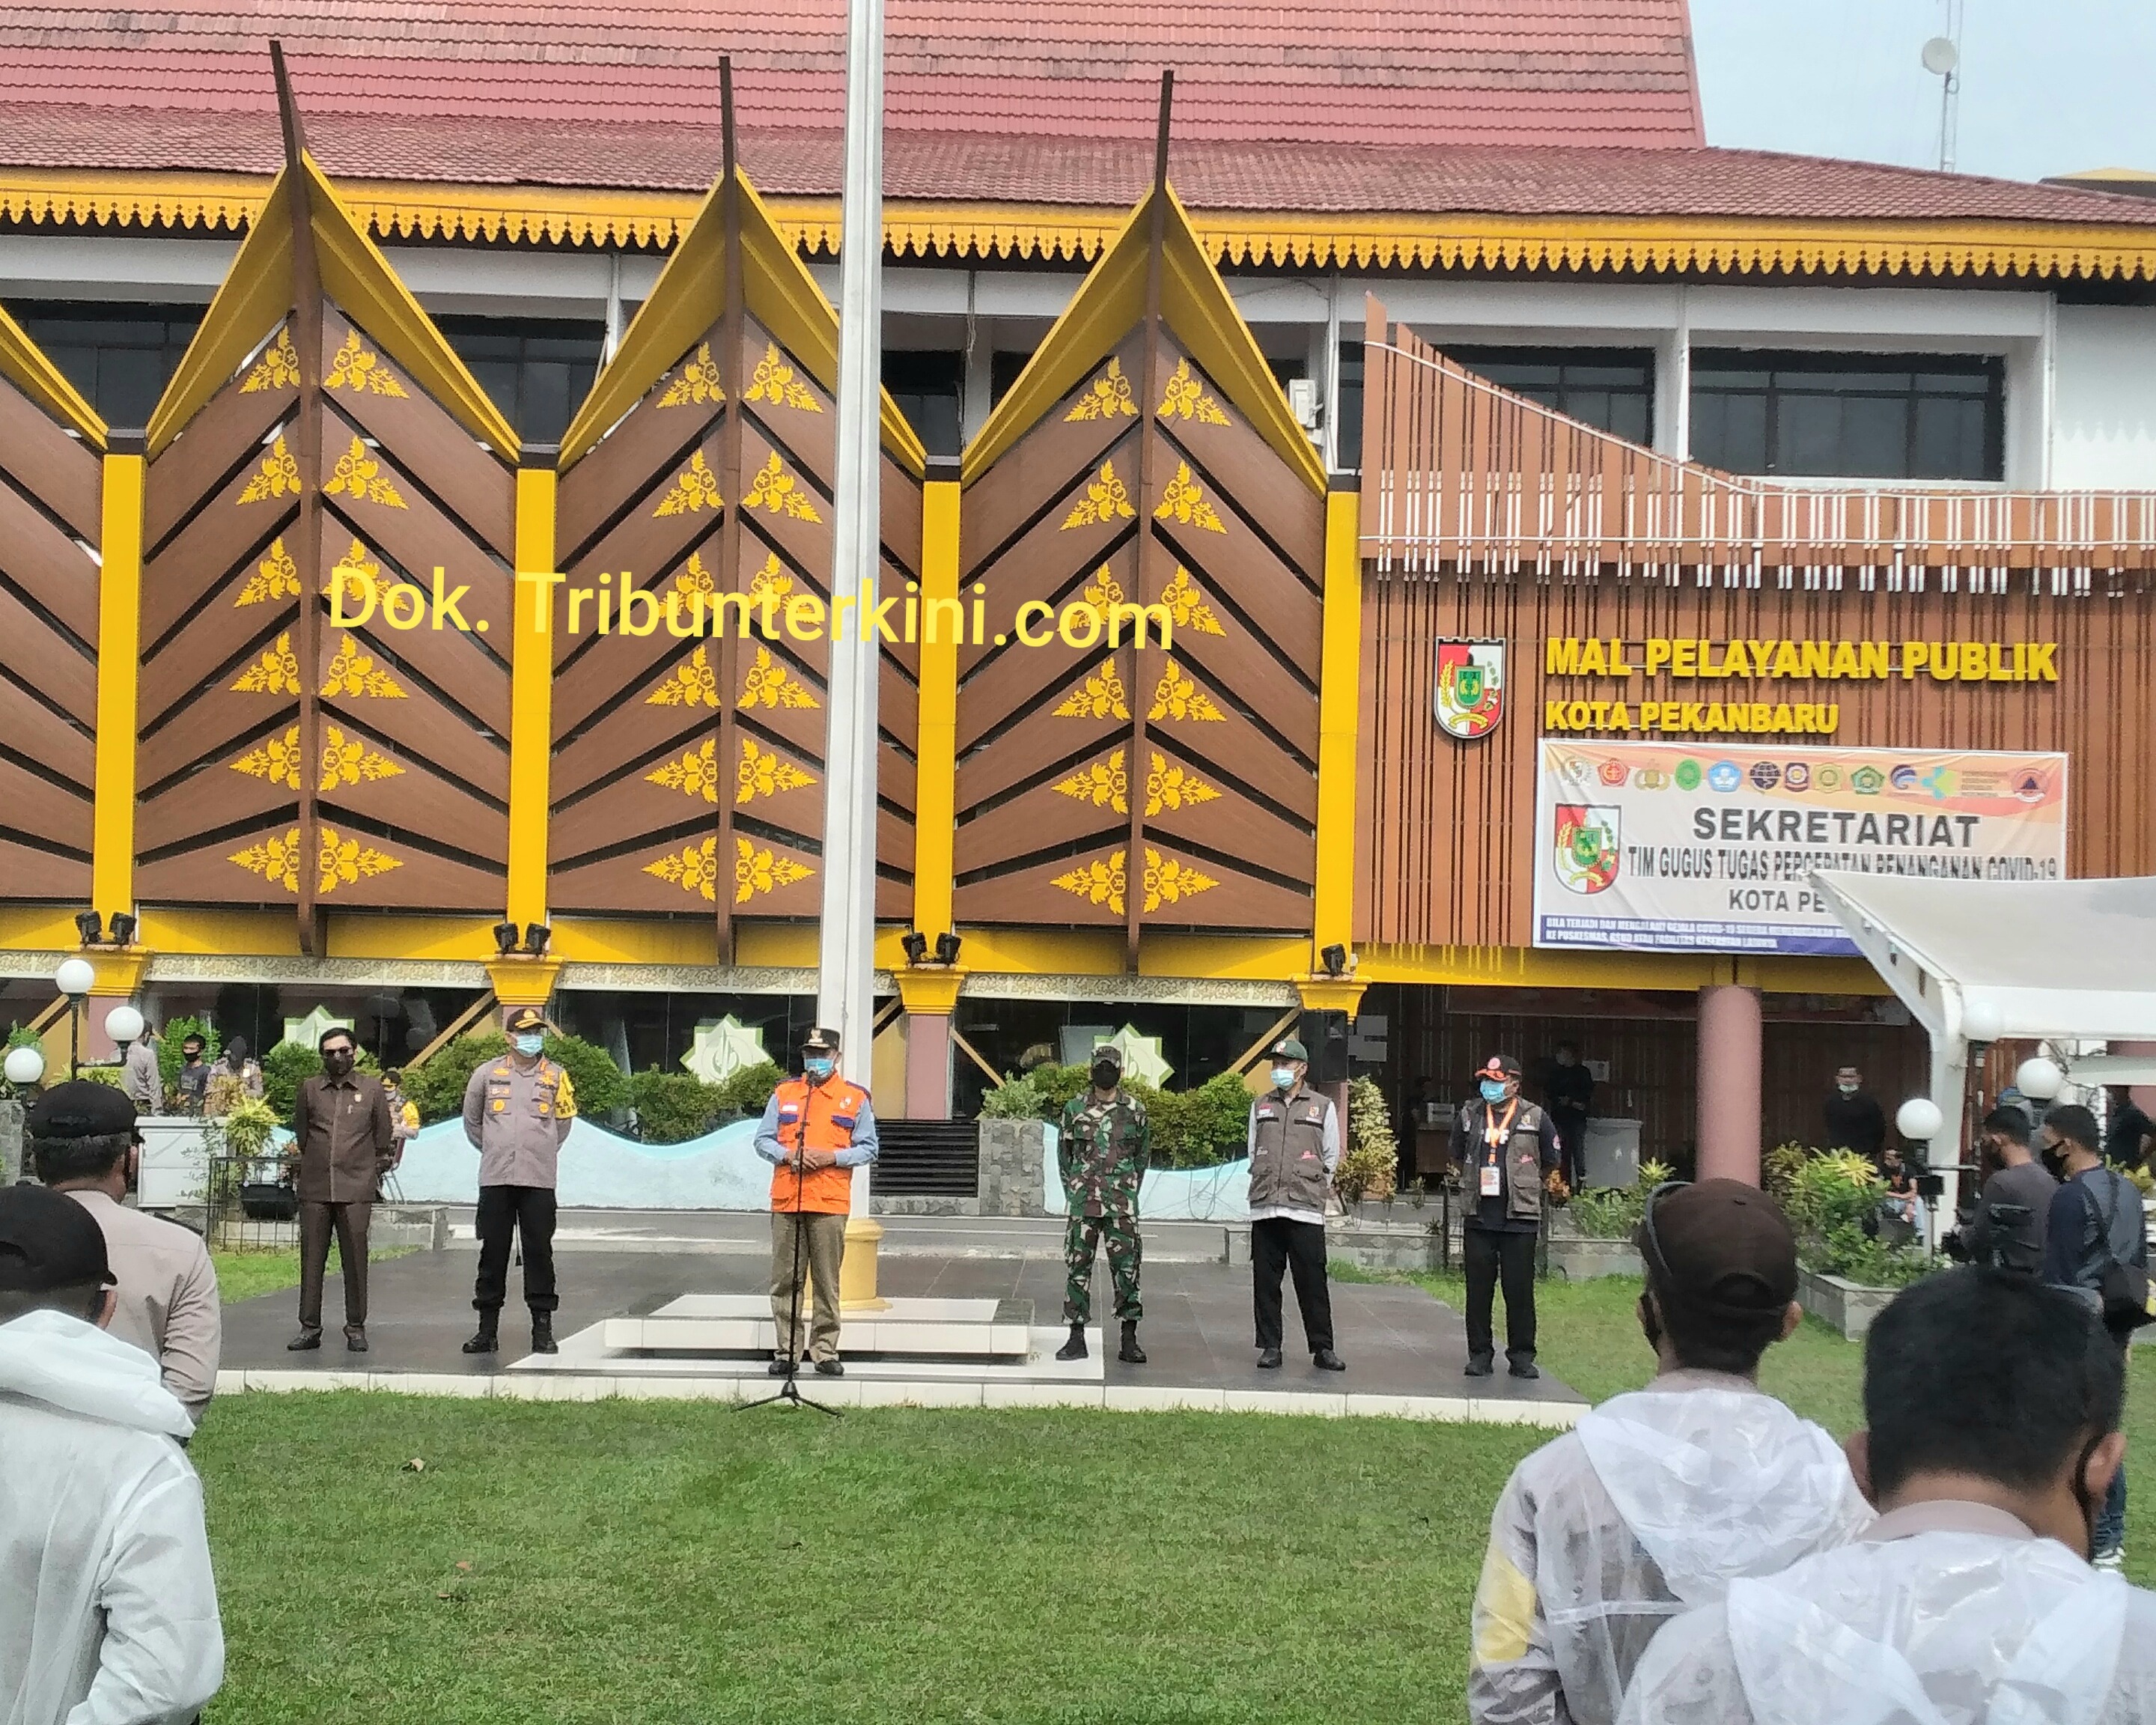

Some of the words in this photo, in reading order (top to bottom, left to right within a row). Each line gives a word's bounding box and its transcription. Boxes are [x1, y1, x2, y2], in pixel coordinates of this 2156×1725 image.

[1546, 636, 1632, 676] MAL
[1645, 638, 1889, 679] PELAYANAN
[1901, 641, 2059, 681] PUBLIK
[1545, 701, 1630, 731] KOTA
[1639, 702, 1839, 734] PEKANBARU
[1693, 807, 1980, 848] SEKRETARIAT
[1628, 846, 1655, 877] TIM
[1660, 847, 1713, 878] GUGUS
[1718, 848, 1768, 880] TUGAS
[1729, 889, 1789, 912] KOTA
